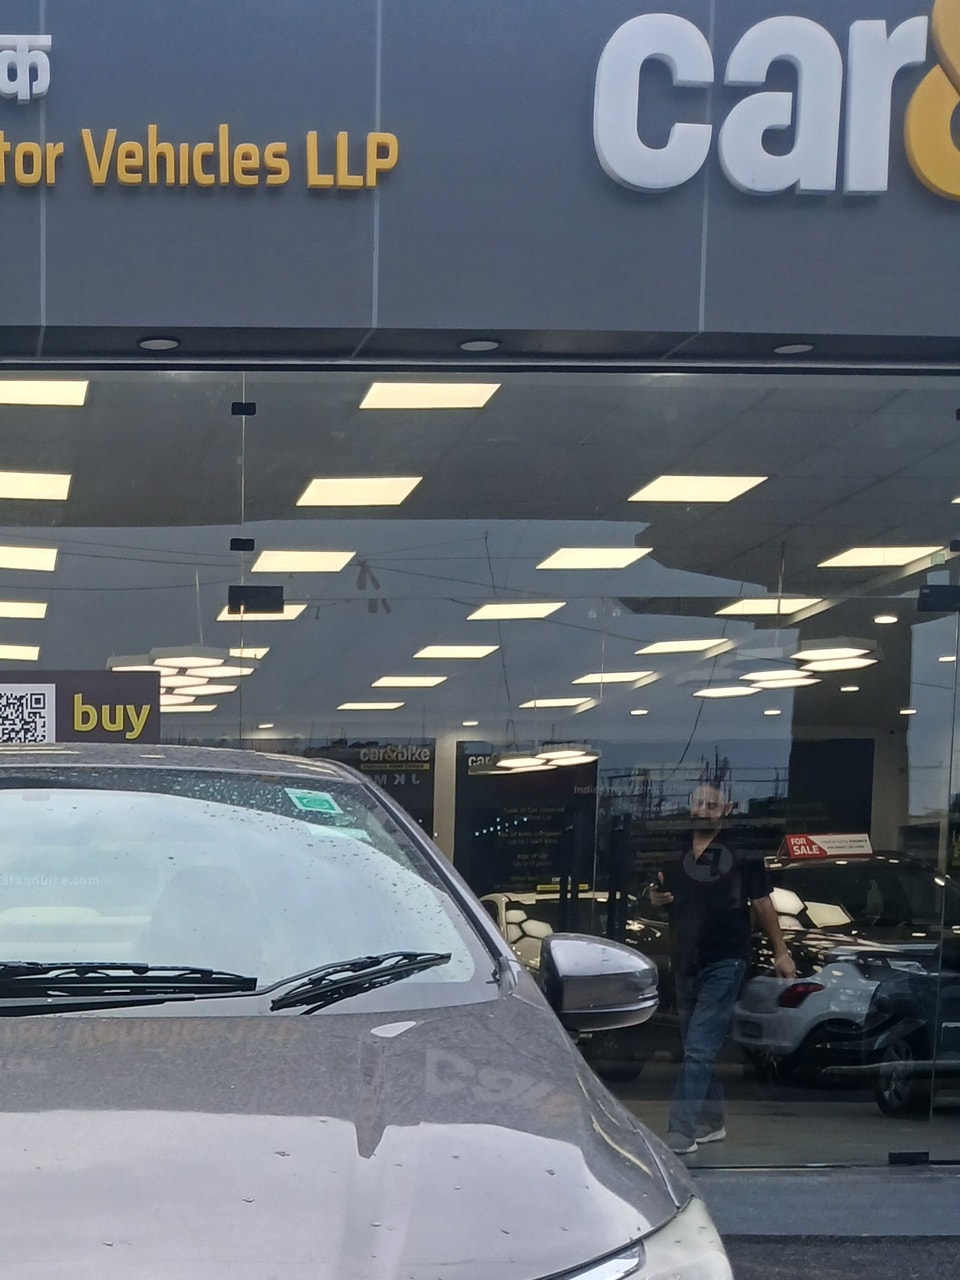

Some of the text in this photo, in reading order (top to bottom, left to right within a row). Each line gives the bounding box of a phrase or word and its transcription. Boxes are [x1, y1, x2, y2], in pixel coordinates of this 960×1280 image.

[81, 124, 291, 189] Vehicles
[307, 131, 399, 190] LLP
[73, 692, 151, 740] buy
[791, 837, 807, 846] FOR
[792, 845, 821, 855] SALE
